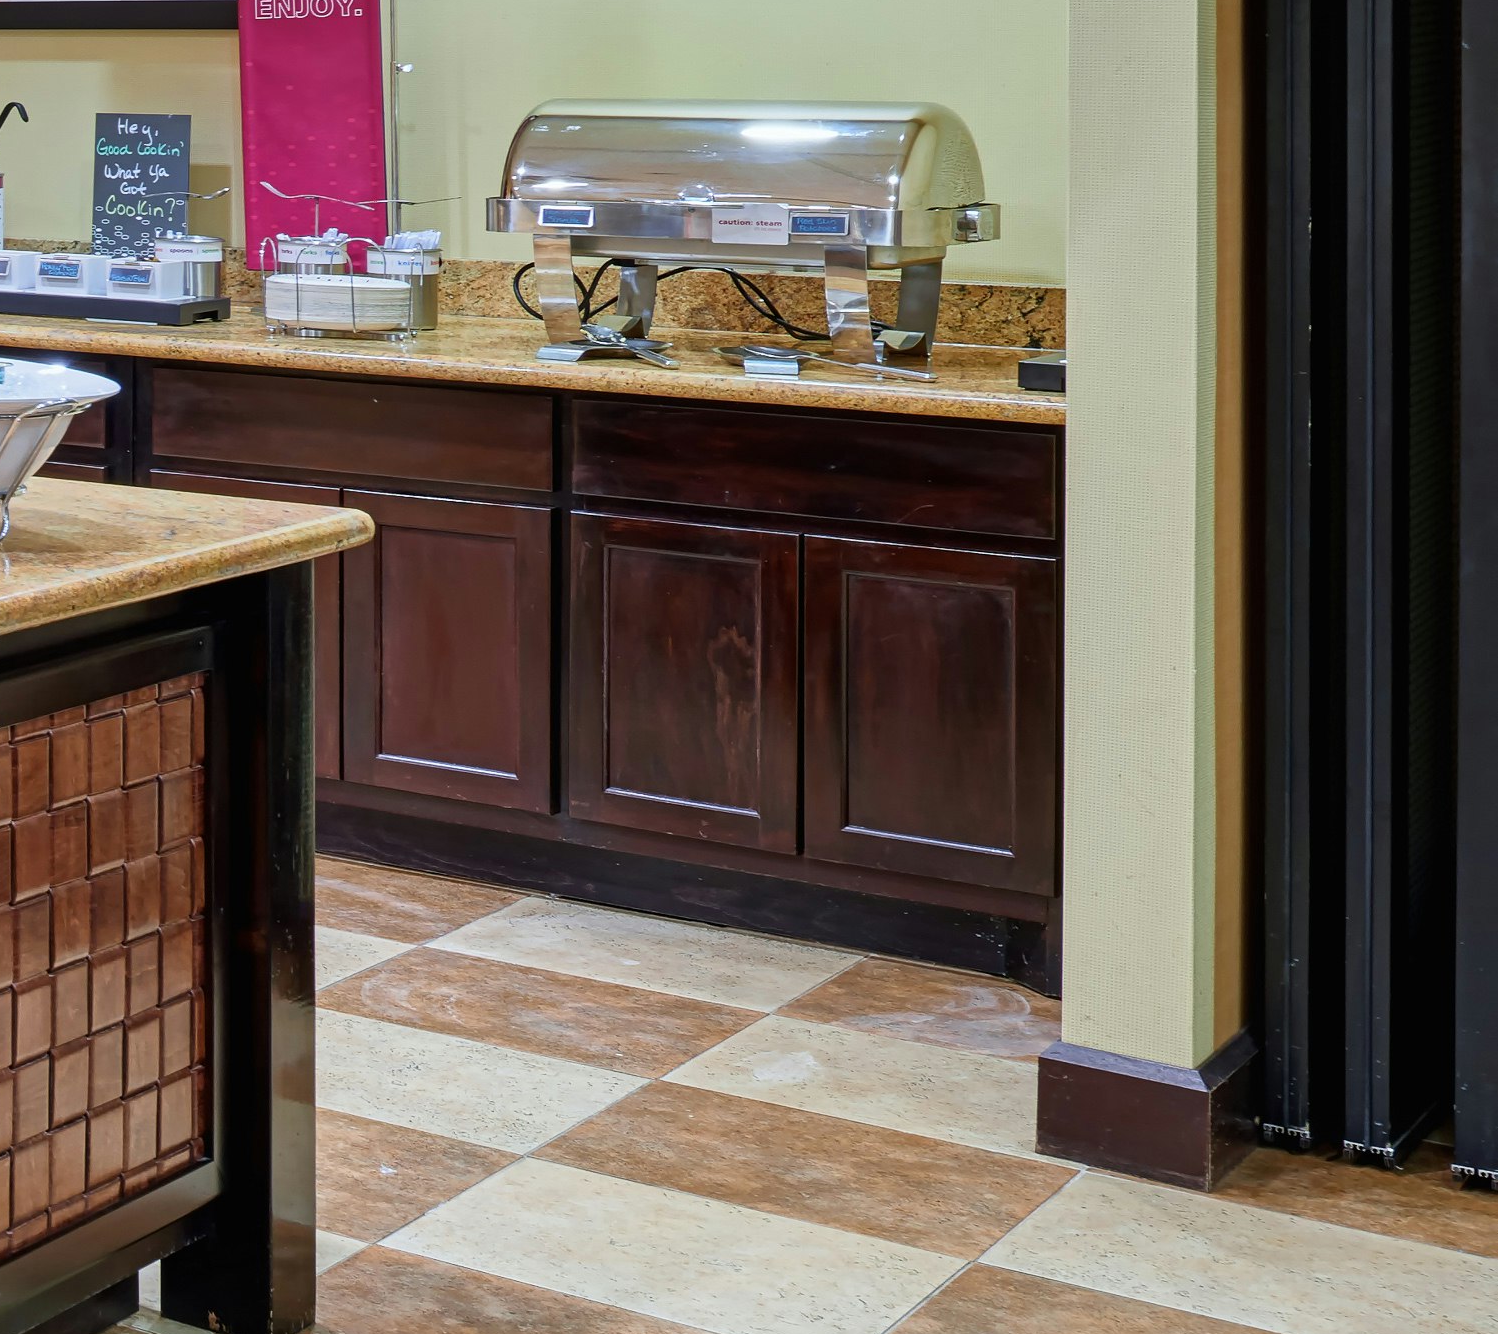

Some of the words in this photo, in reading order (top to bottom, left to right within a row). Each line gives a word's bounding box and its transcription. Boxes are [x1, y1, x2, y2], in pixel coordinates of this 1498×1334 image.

[96, 137, 133, 156] Good
[104, 162, 142, 180] What
[120, 182, 148, 196] Got
[755, 219, 783, 227] steam
